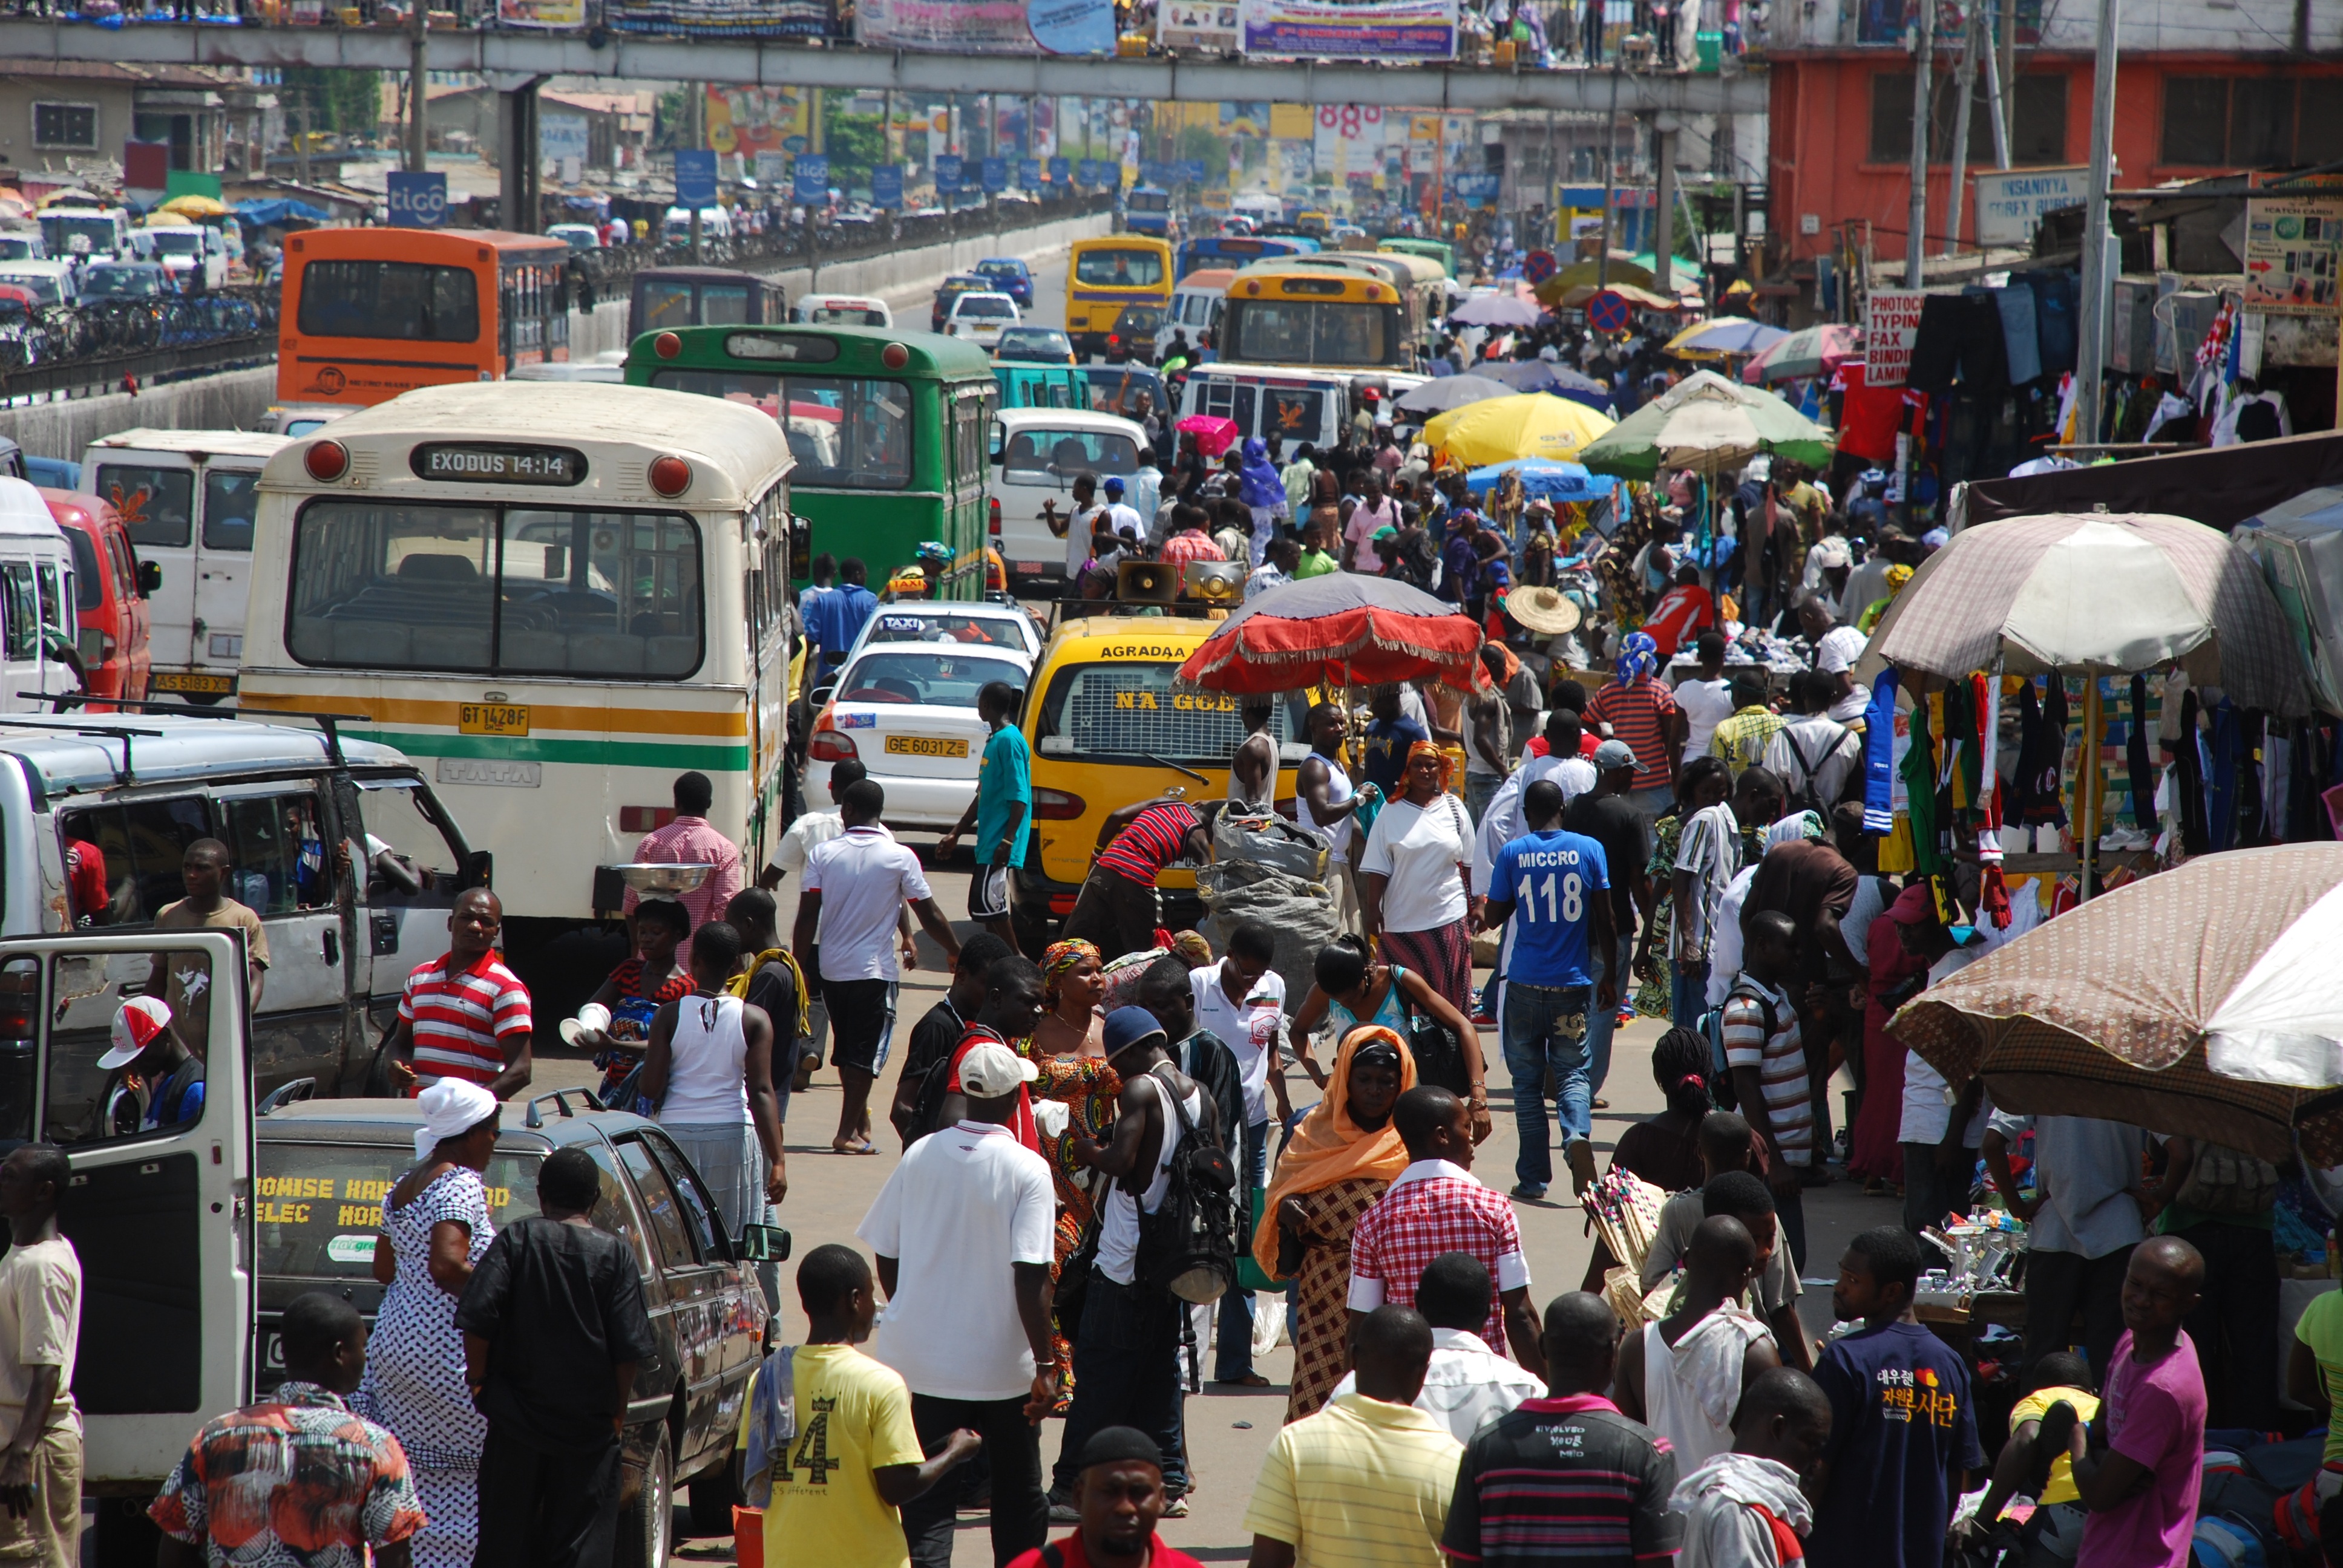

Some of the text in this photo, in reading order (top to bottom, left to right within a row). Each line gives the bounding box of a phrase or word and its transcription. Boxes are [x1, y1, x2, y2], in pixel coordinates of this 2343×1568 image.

[2002, 177, 2068, 197] INSANIYYA
[390, 184, 446, 213] tigo
[1988, 200, 2030, 217] FOREX
[1870, 332, 1901, 347] FAX
[432, 452, 563, 475] EXODUS 14:14
[894, 580, 922, 588] TAXI
[885, 616, 918, 627] TAXI
[1101, 645, 1186, 658] AGRADAA
[157, 676, 177, 689] AS
[181, 676, 209, 690] 5183
[1173, 694, 1236, 712] GOD
[462, 706, 480, 724] GT
[889, 737, 957, 756] GE 6031 Z
[445, 761, 532, 783] TATA
[1518, 851, 1579, 868] MICCRO
[1518, 872, 1583, 923] 118
